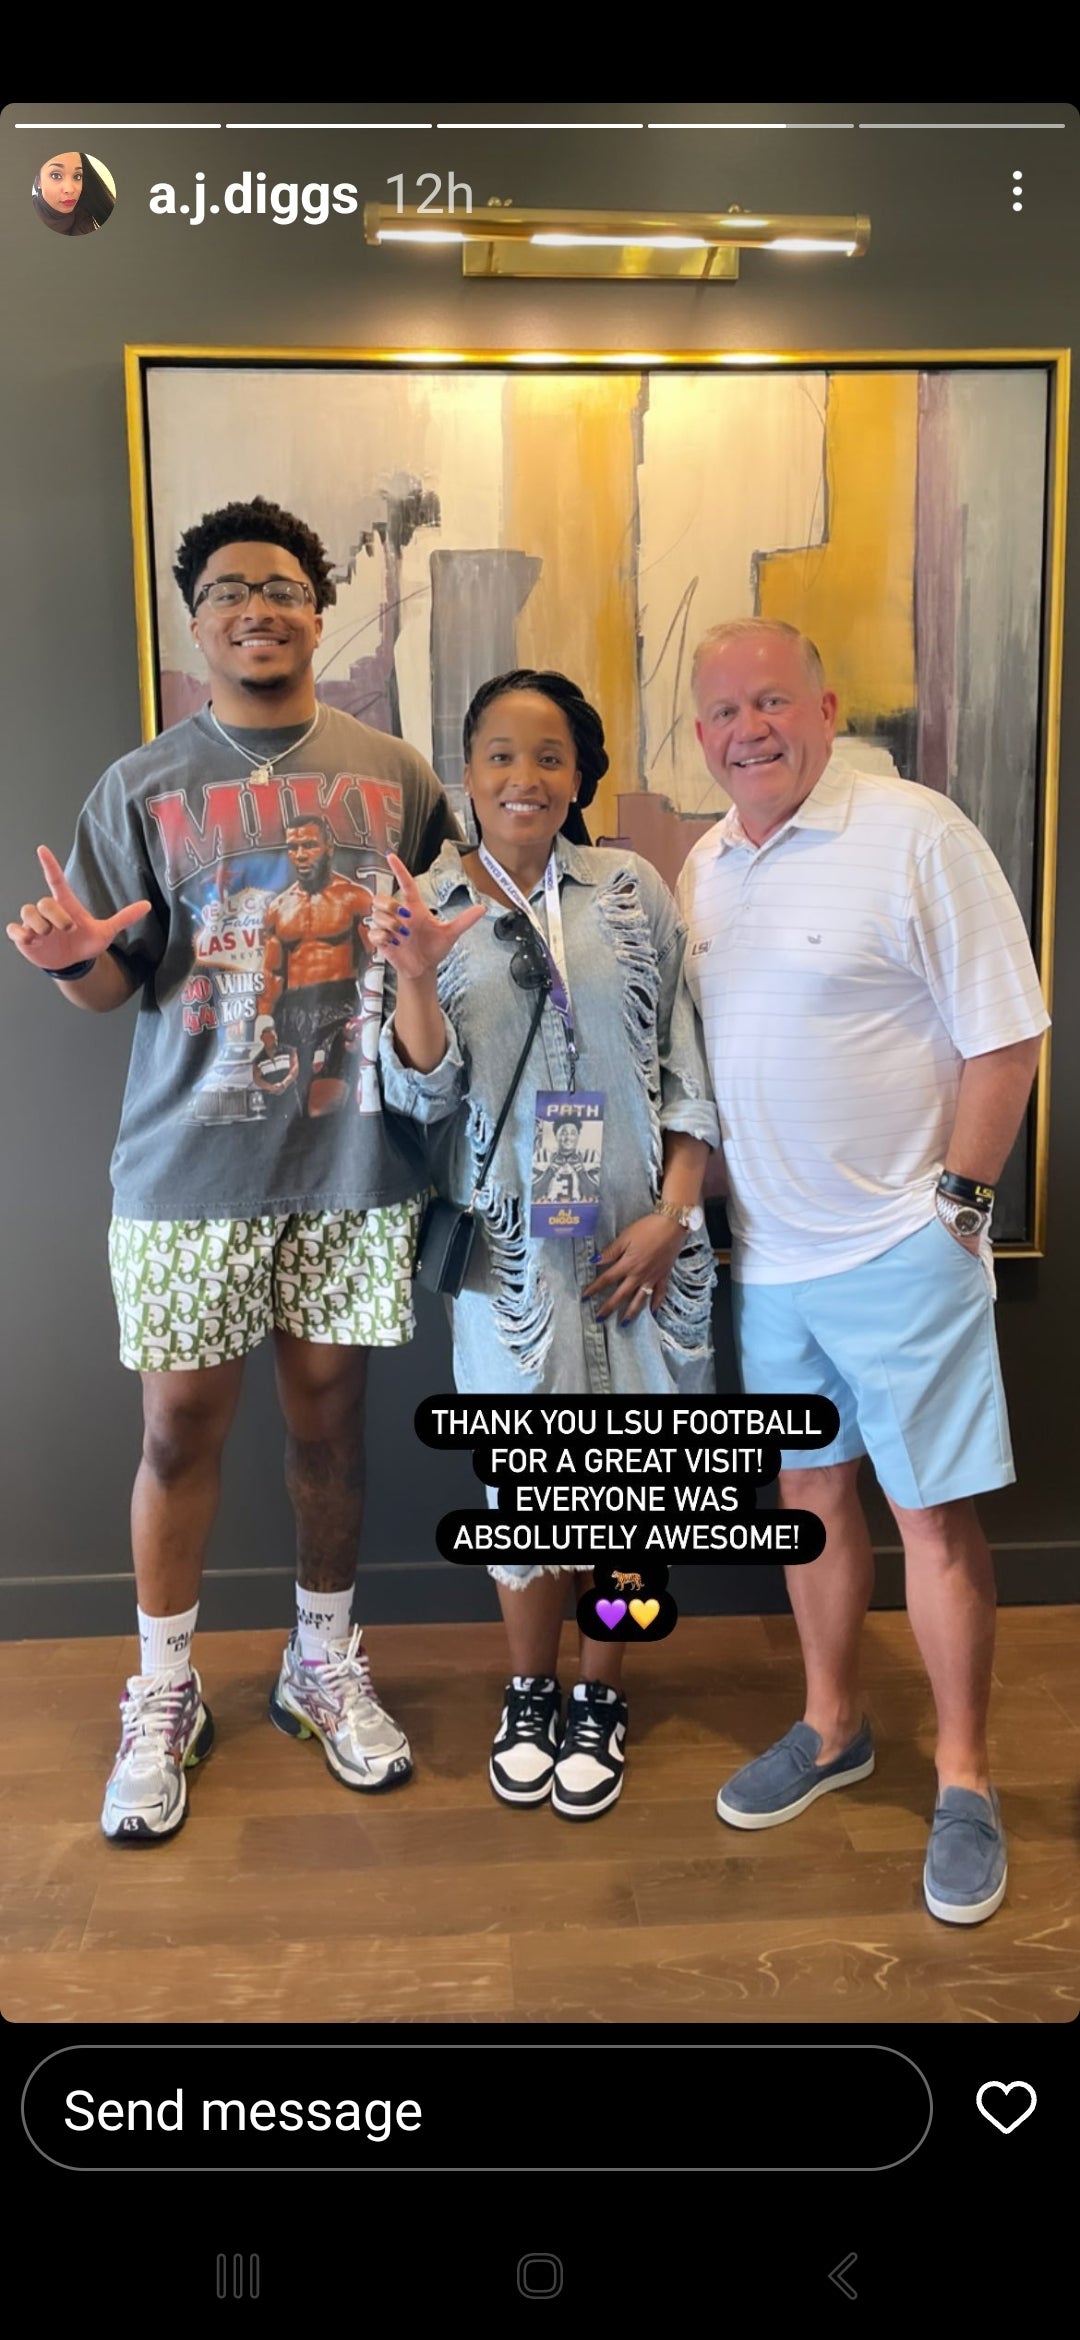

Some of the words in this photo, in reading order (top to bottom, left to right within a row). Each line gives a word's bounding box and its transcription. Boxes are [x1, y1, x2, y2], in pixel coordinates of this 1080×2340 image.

[146, 772, 403, 890] MIKE
[215, 972, 265, 995] WINS
[546, 1104, 600, 1118] PATH
[548, 1216, 580, 1225] DIGGS
[393, 1758, 407, 1772] 43
[123, 1817, 139, 1831] 43
